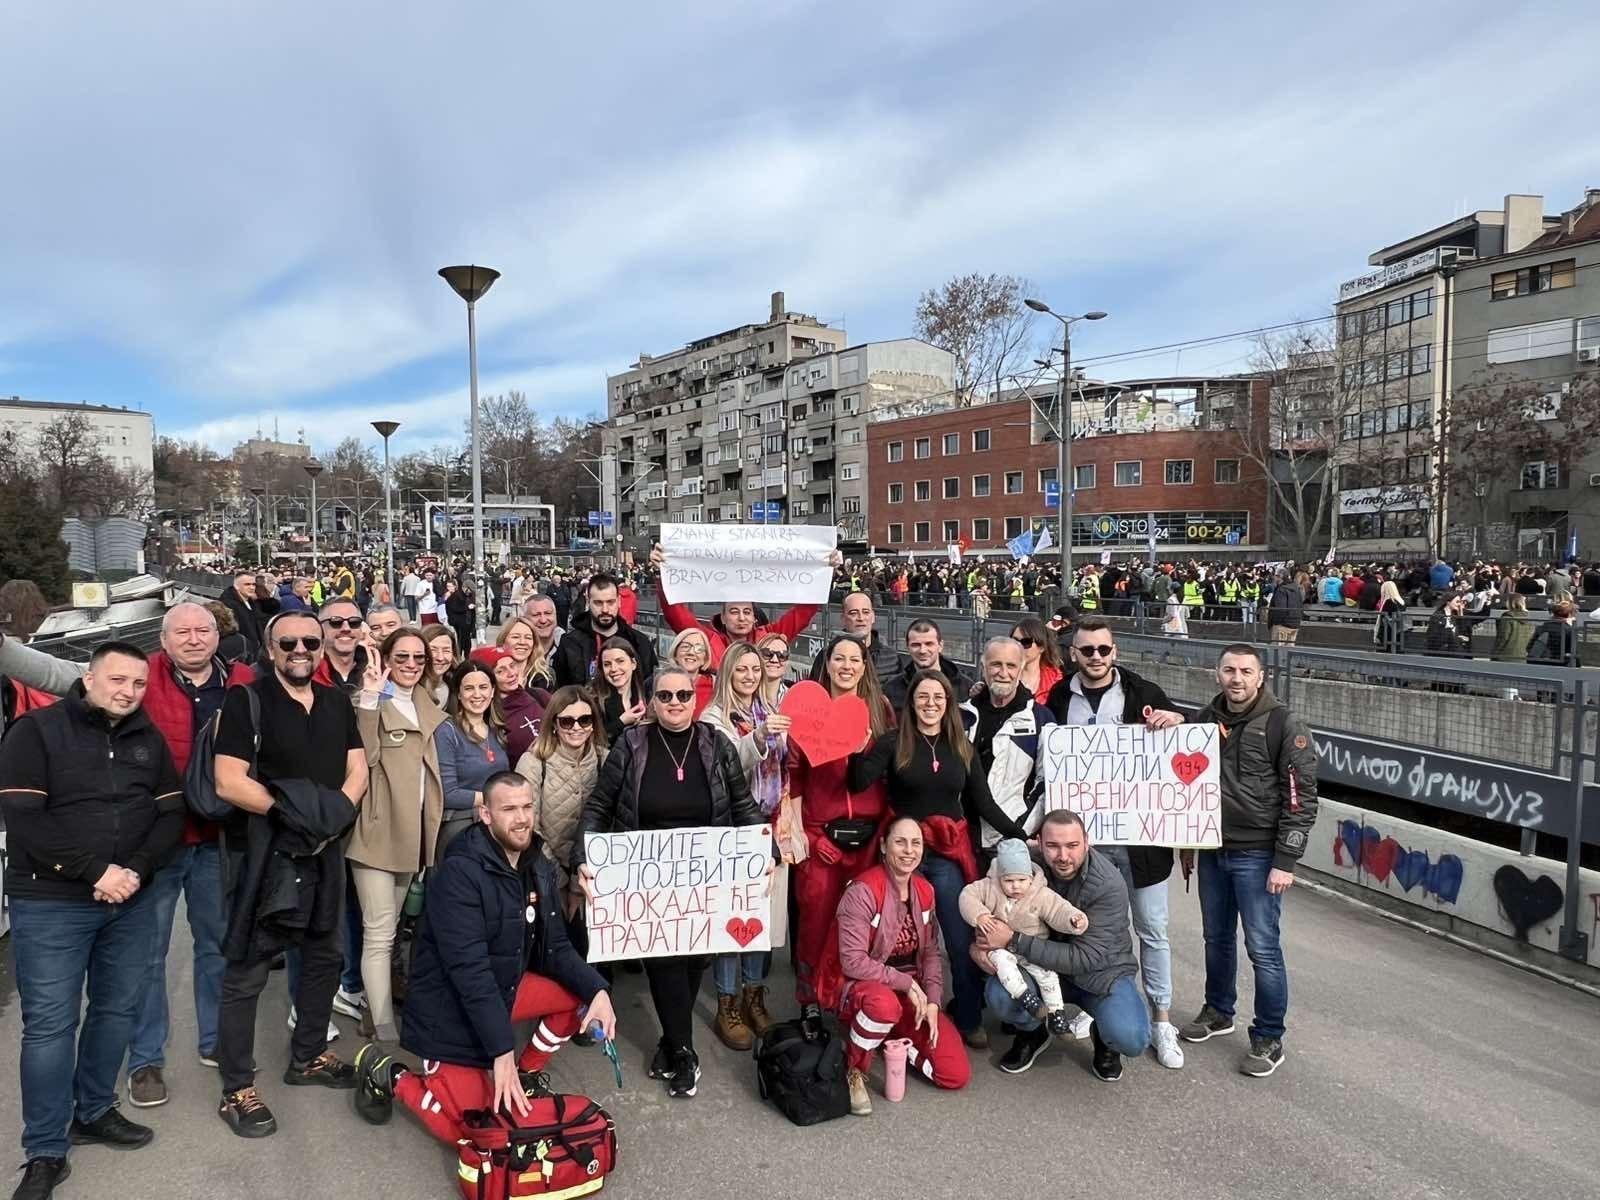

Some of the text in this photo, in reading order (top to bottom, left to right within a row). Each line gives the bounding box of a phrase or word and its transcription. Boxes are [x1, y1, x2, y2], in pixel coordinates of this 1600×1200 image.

[1154, 527, 1169, 539] 24
[1187, 525, 1231, 538] 00-24
[750, 547, 817, 563] PROPADA
[666, 567, 814, 585] BRAVO DRŽAVO
[1047, 725, 1217, 755] СТУДЕНТИ СУ
[1049, 754, 1162, 783] УПУТИЛИ
[1176, 760, 1201, 776] 194
[1148, 781, 1220, 811] ПОЗИВ
[1077, 811, 1221, 843] ИЖЕ ХИТНА
[718, 829, 753, 856] СЕ
[595, 853, 765, 896] СЛОЈЕВИТО
[592, 883, 761, 926] БЛОКАДЕ ЋЕ
[590, 917, 712, 955] ТРАЈАТИ
[732, 926, 755, 940] 194
